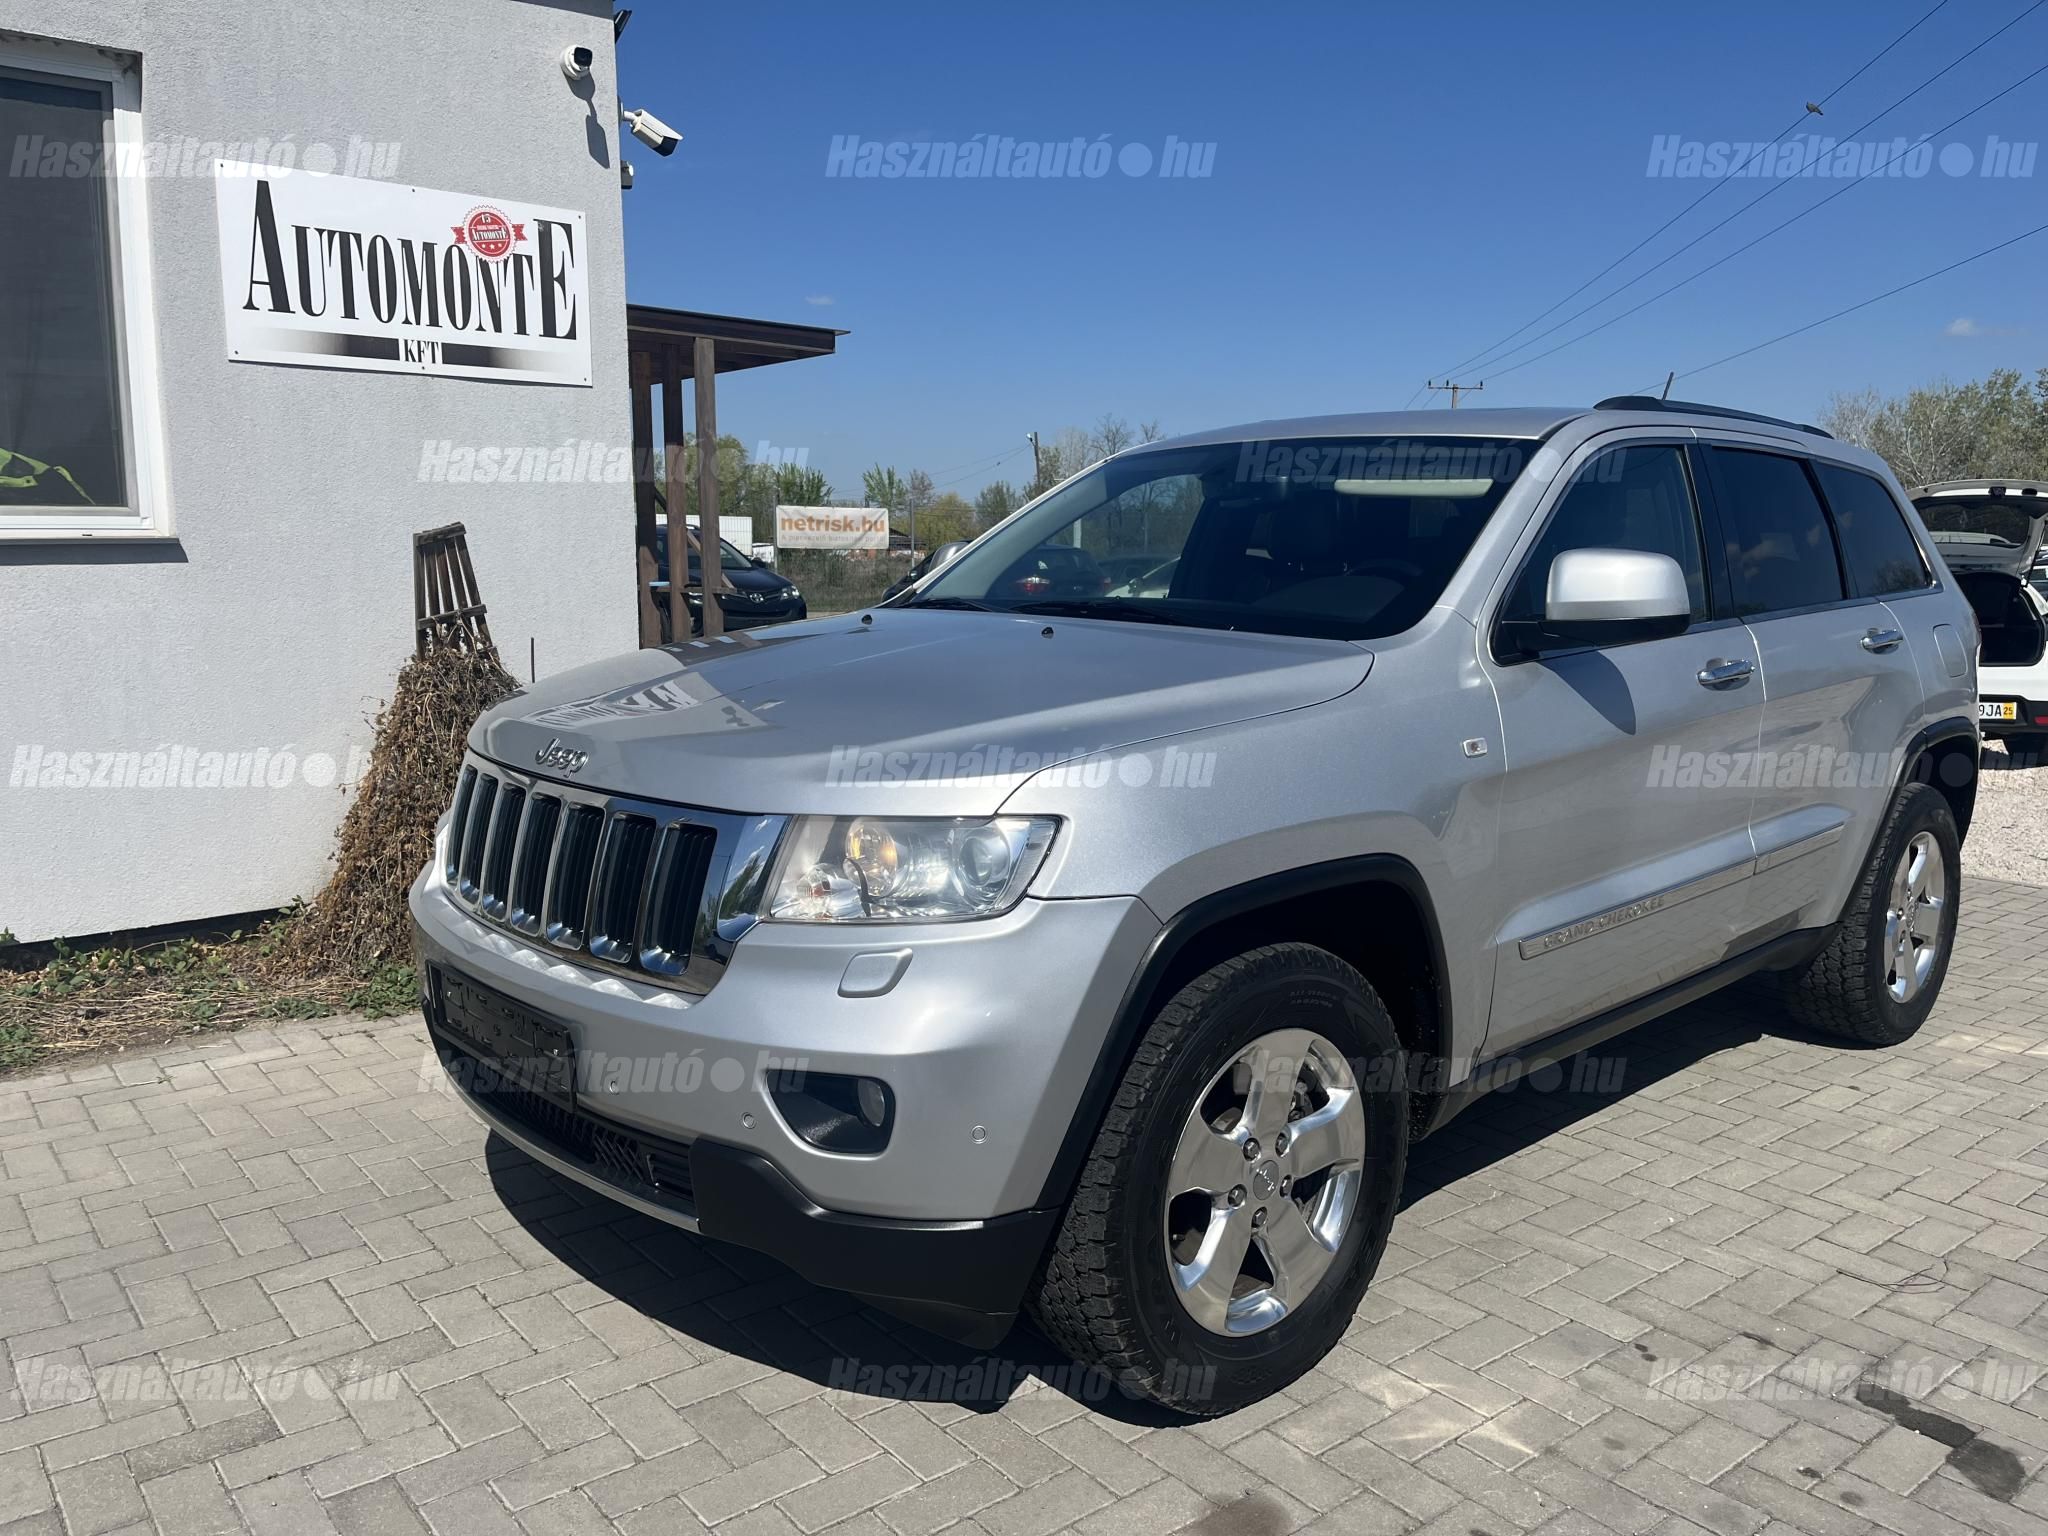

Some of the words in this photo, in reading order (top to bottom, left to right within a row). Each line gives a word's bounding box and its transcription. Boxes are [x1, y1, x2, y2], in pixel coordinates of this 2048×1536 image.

[403, 338, 440, 365] KFT
[781, 514, 885, 532] netrisk.hu
[535, 737, 590, 778] Jeep
[1543, 923, 1595, 949] GRAND
[1599, 895, 1665, 928] CHEROKEE
